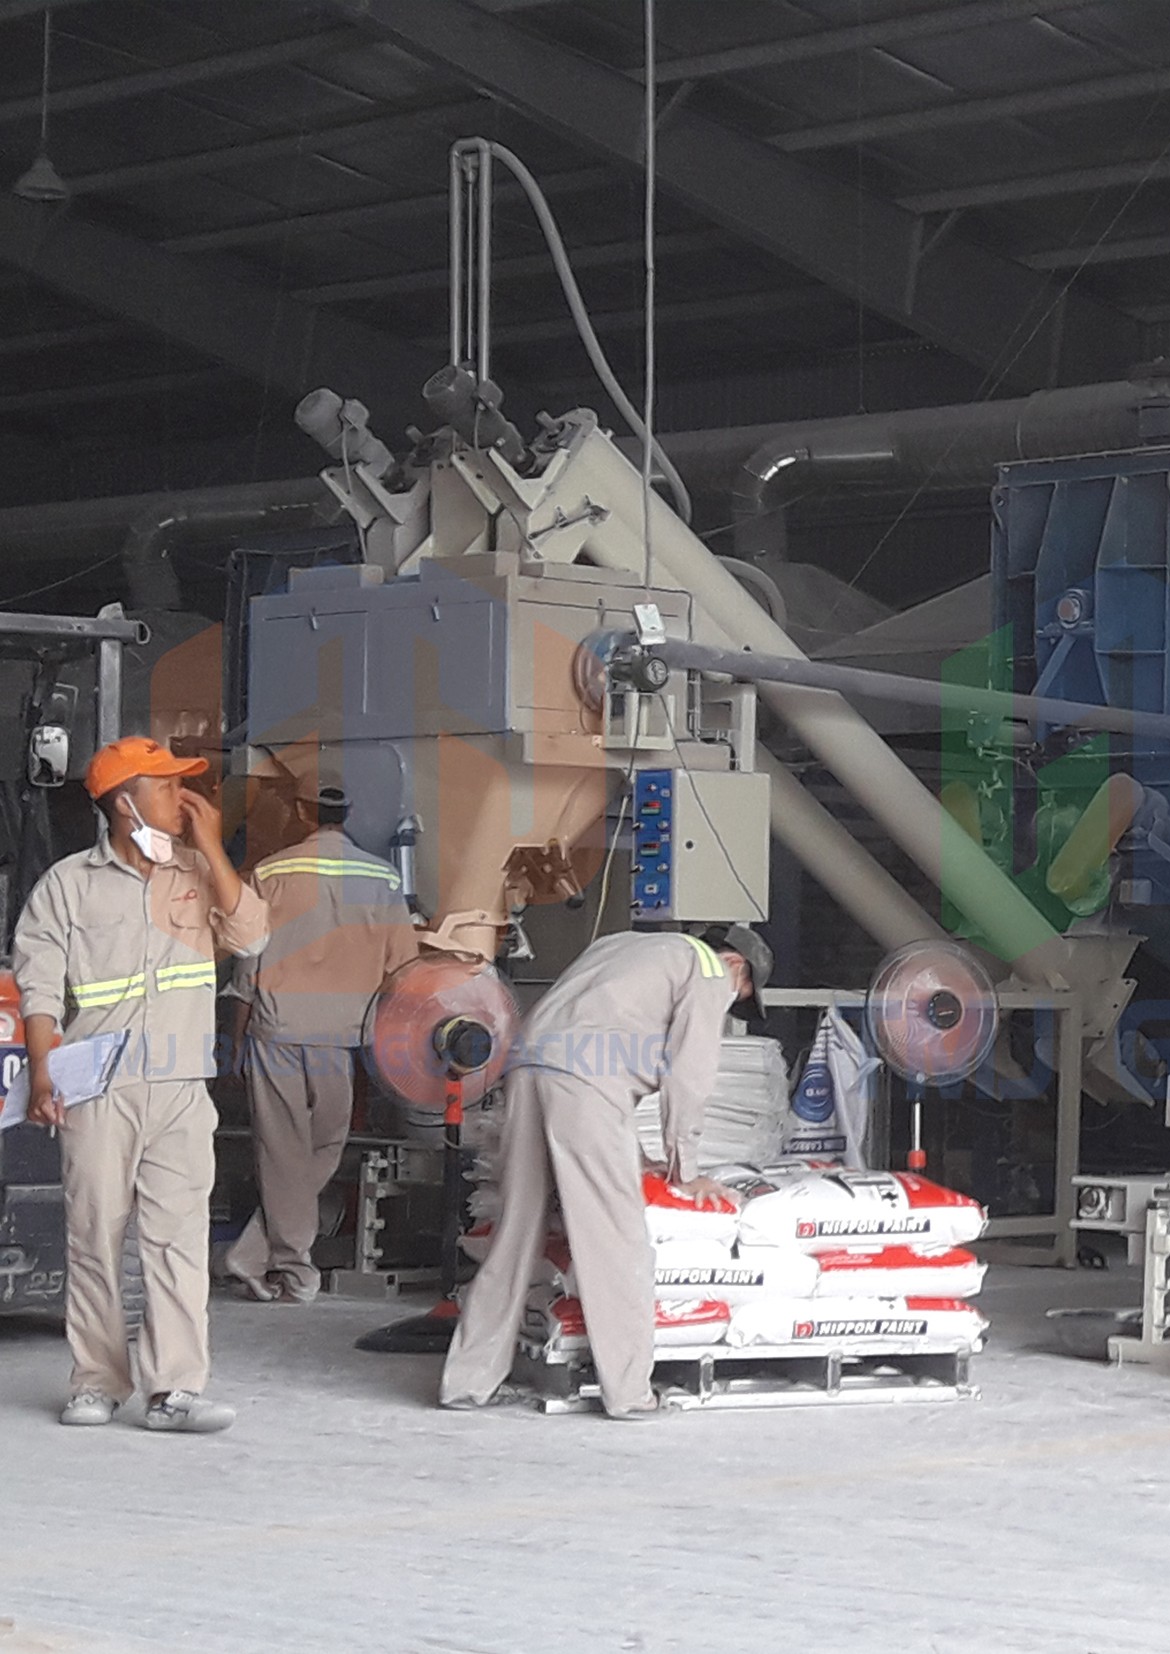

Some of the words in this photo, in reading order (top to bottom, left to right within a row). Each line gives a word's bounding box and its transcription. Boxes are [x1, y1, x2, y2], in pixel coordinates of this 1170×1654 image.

[822, 1219, 879, 1234] NIPPON
[882, 1217, 927, 1233] PAINT
[714, 1269, 760, 1284] PAINT
[819, 1321, 877, 1335] NIPPON
[880, 1320, 925, 1335] PAINT
